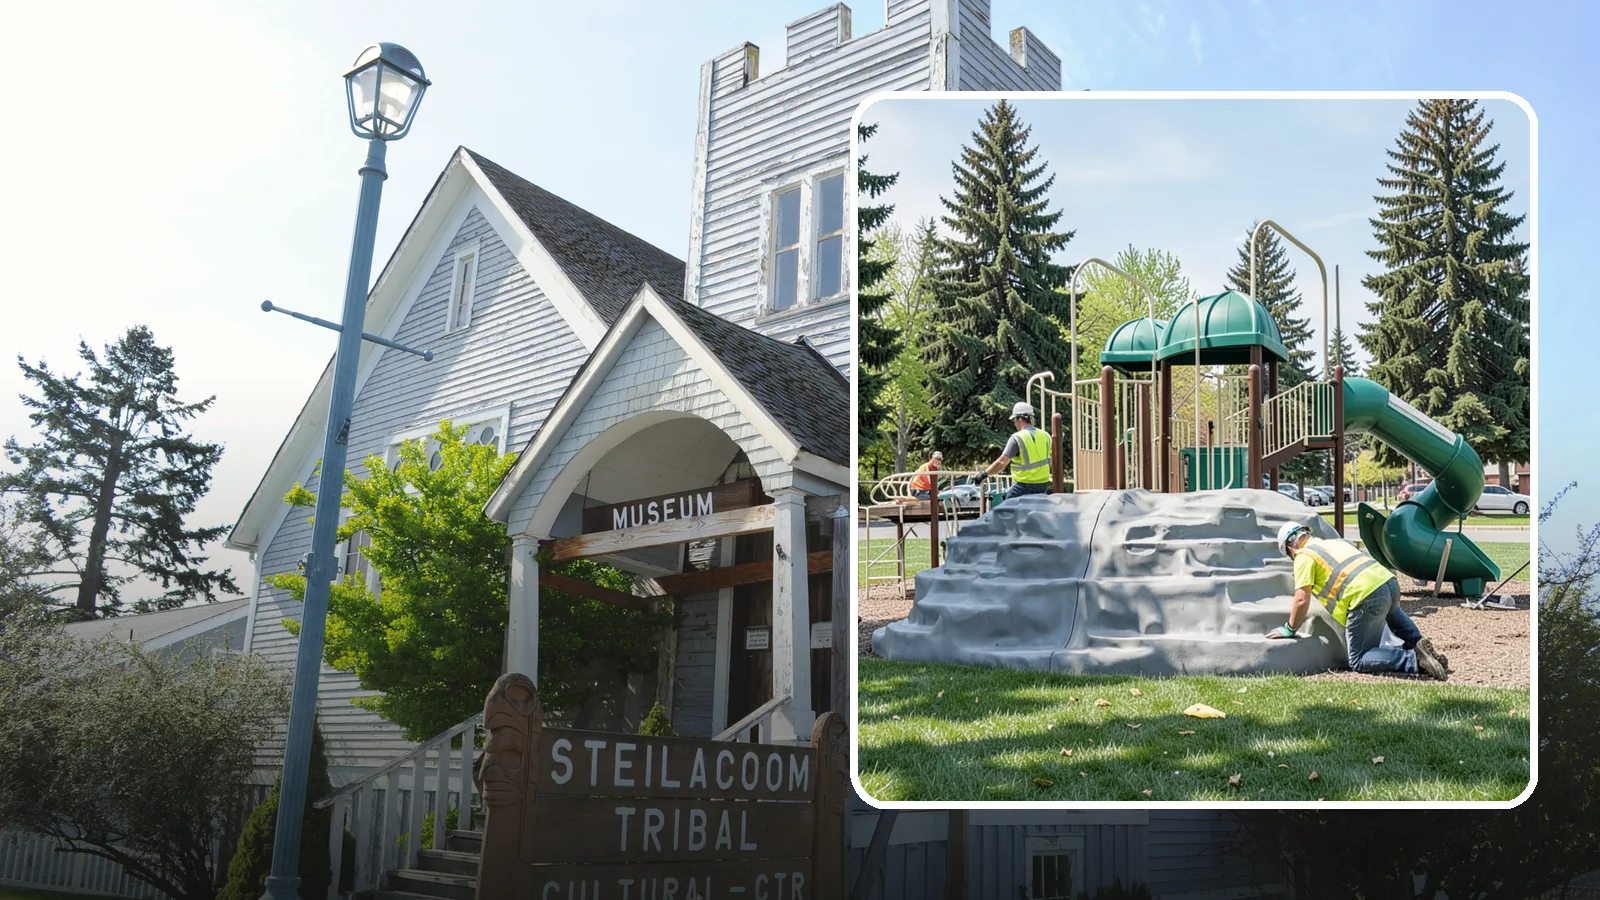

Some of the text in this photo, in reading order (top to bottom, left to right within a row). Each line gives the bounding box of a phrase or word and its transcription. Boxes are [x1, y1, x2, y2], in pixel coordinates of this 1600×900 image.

[613, 491, 713, 530] MUSEUM
[551, 738, 809, 792] STEILACOOM
[615, 806, 757, 852] TRIBAL
